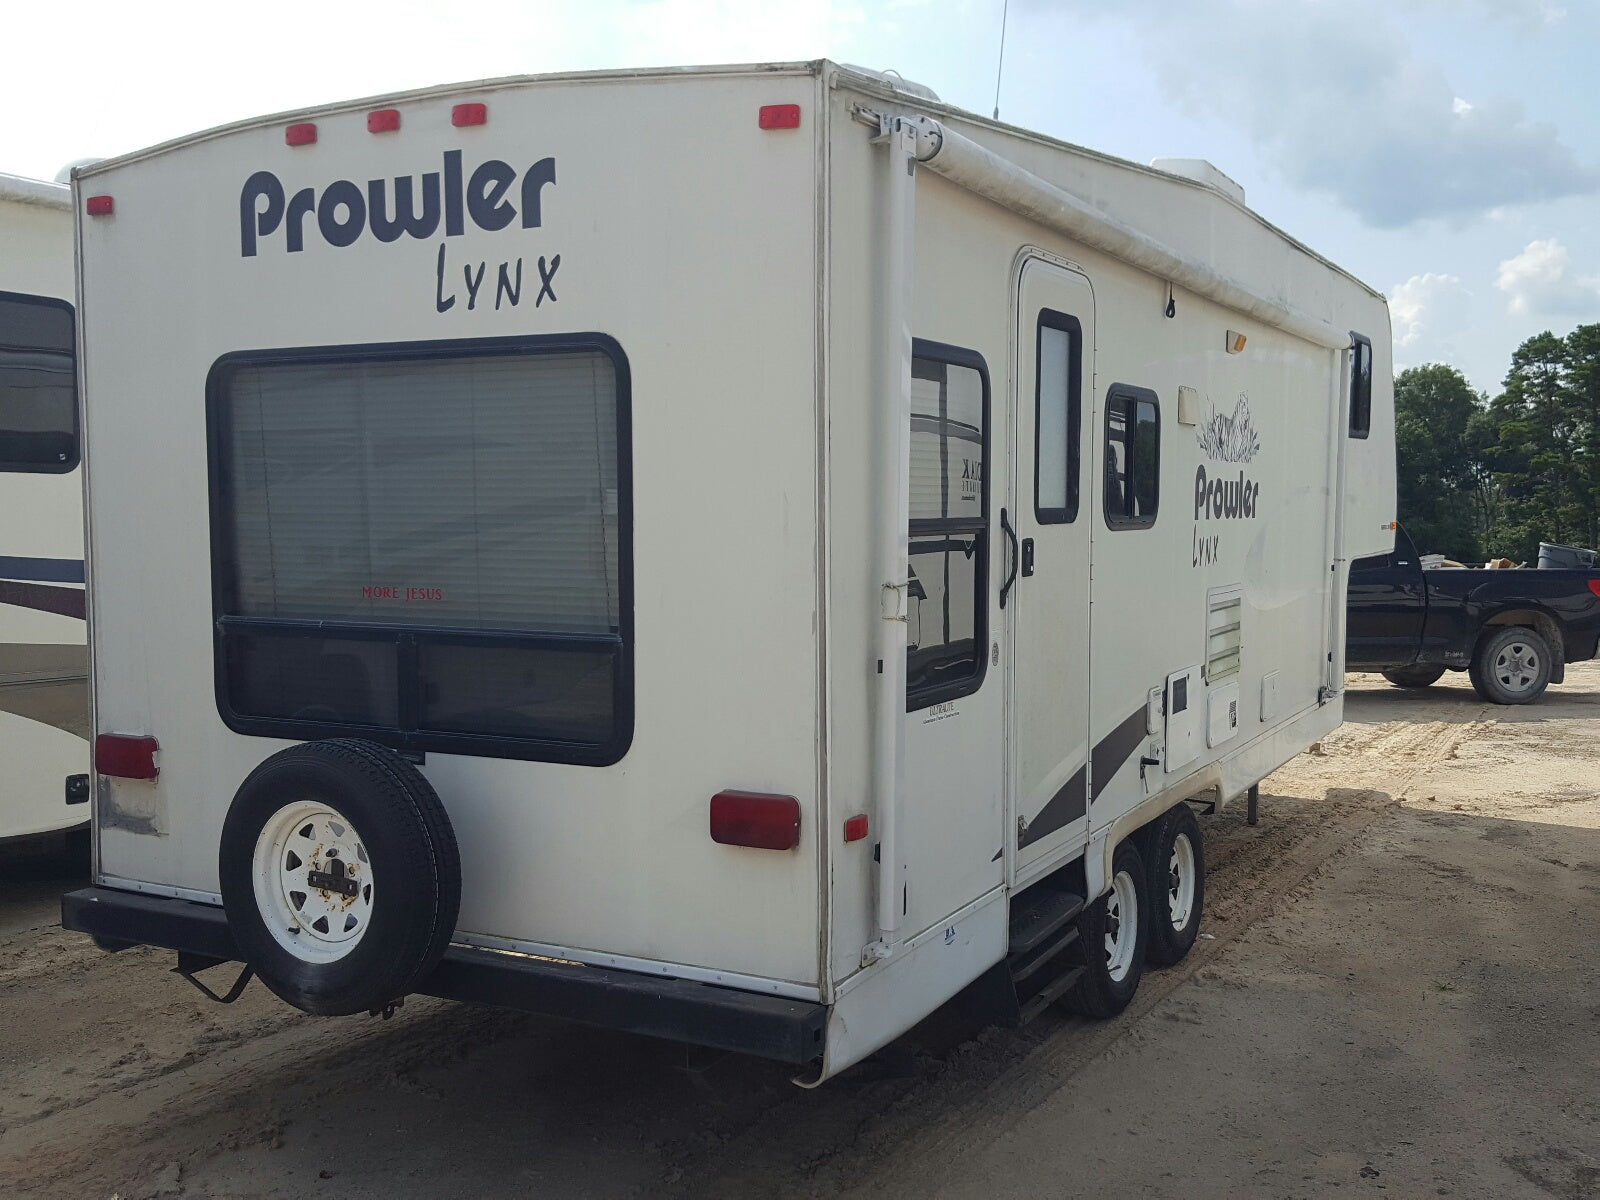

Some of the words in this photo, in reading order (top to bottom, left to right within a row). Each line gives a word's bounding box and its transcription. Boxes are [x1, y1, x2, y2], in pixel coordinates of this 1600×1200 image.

[240, 149, 557, 258] Prowler
[1194, 464, 1259, 521] Prowler
[362, 585, 400, 599] MORE
[405, 586, 442, 602] JESUS
